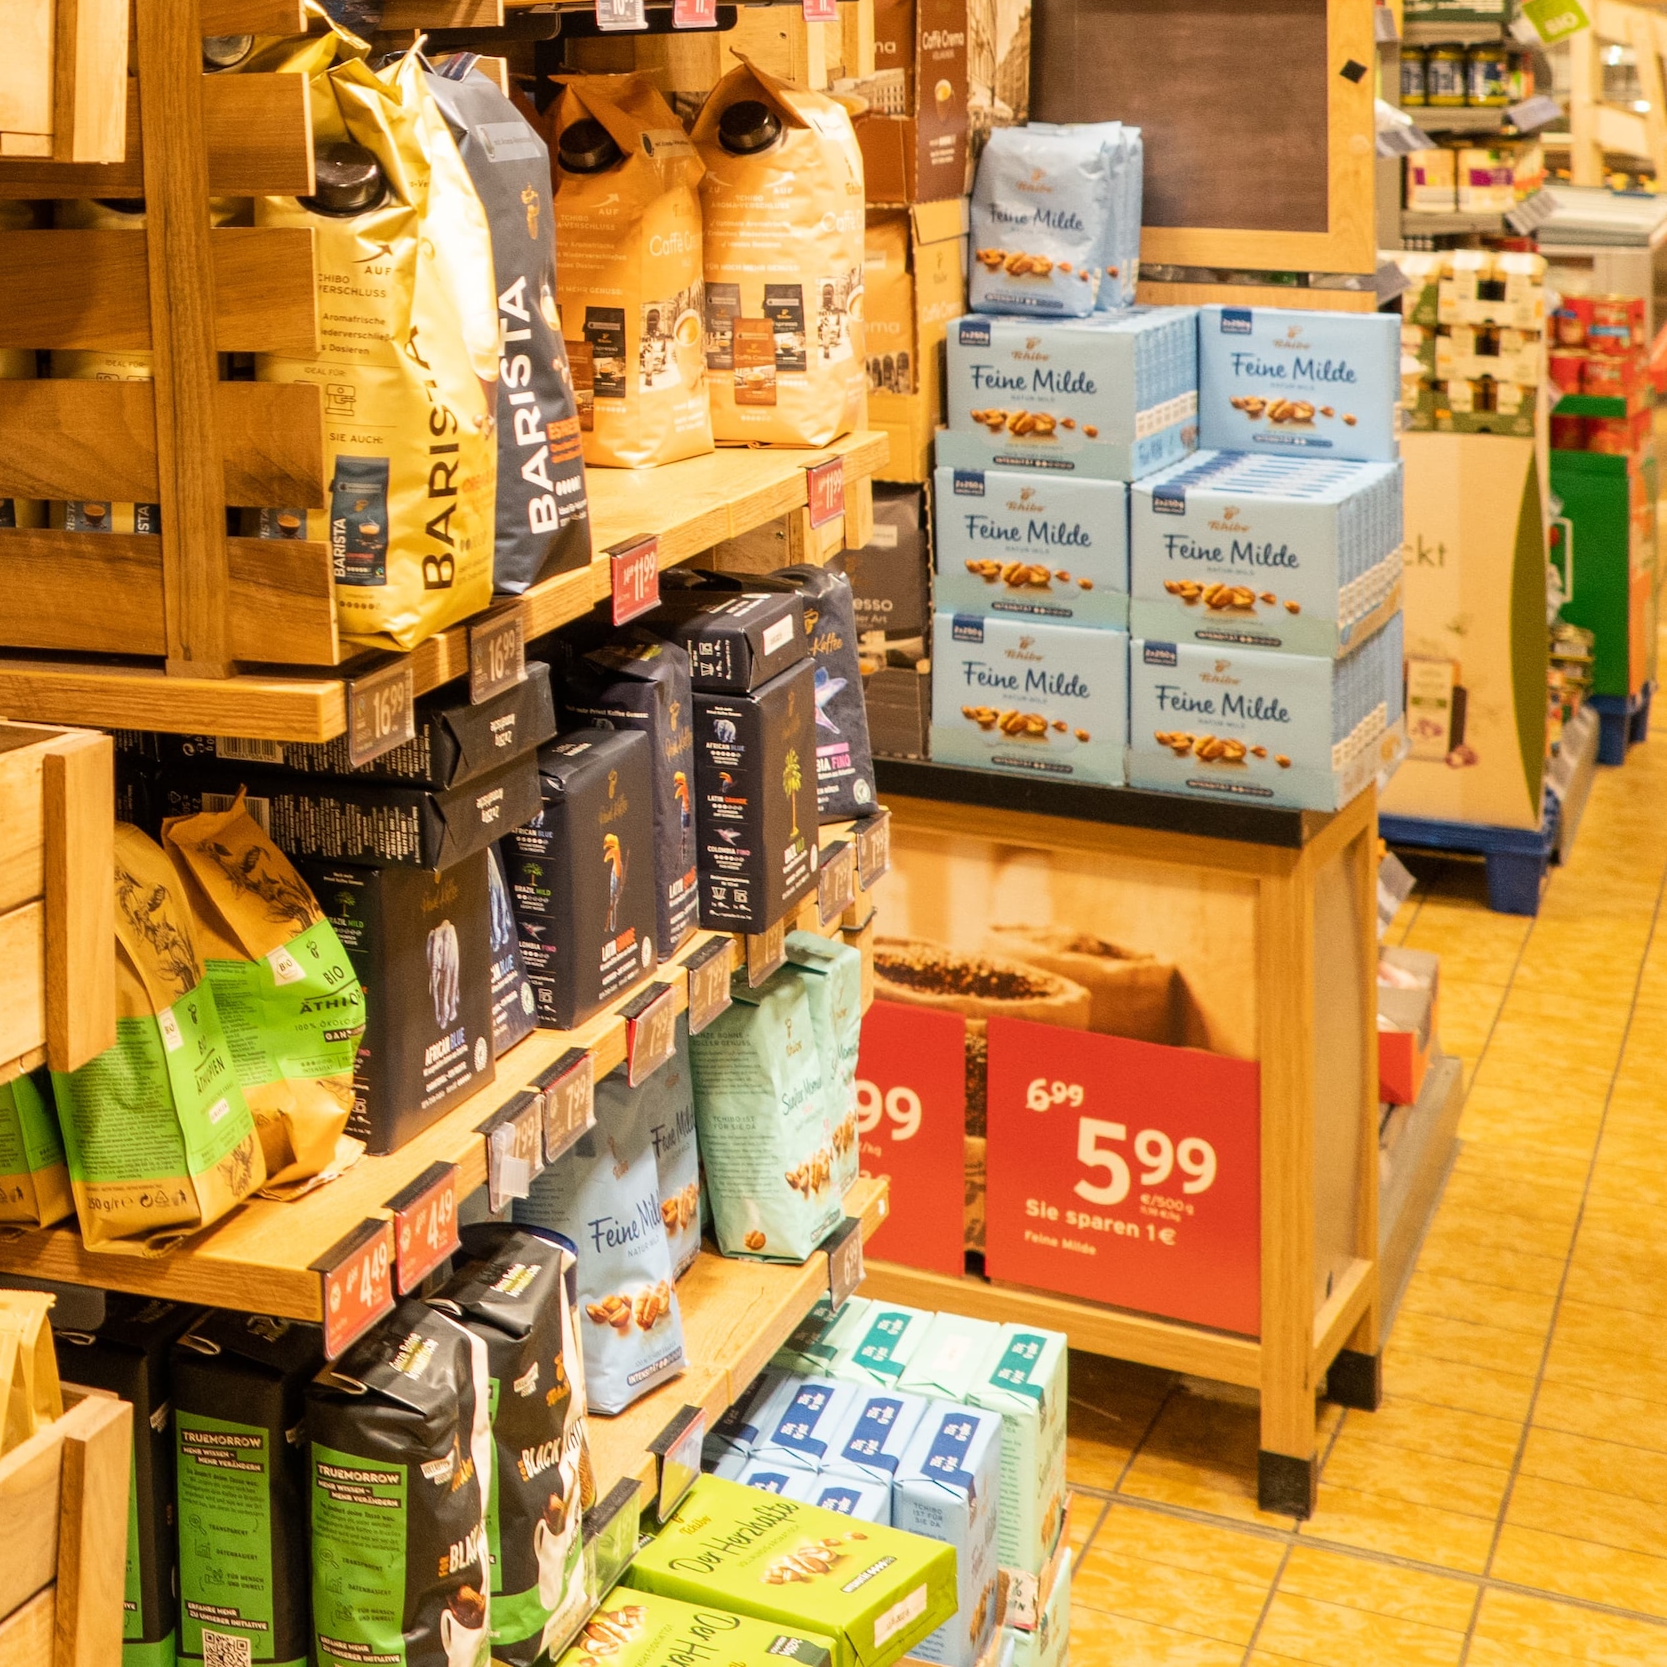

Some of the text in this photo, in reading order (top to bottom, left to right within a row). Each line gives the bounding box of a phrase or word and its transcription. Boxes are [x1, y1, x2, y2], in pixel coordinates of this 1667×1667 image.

[923, 31, 964, 50] Caffè Crema
[990, 202, 1083, 233] Feine Milde
[323, 312, 385, 326] Aromafrische
[970, 365, 1096, 394] Feine Milde
[1232, 352, 1357, 383] Feine Milde
[498, 276, 561, 535] BARISTA
[965, 514, 1091, 548] Feine Milde
[1165, 534, 1299, 570] Feine Milde
[962, 661, 1090, 698] Feine Milde
[1155, 684, 1291, 723] Feine Milde
[1026, 1199, 1059, 1219] Sie
[1066, 1206, 1140, 1237] sparen
[183, 1431, 261, 1448] TRUEMORROW
[318, 1464, 399, 1483] TRUEMORROW
[669, 1502, 798, 1574] Der Herzhafte
